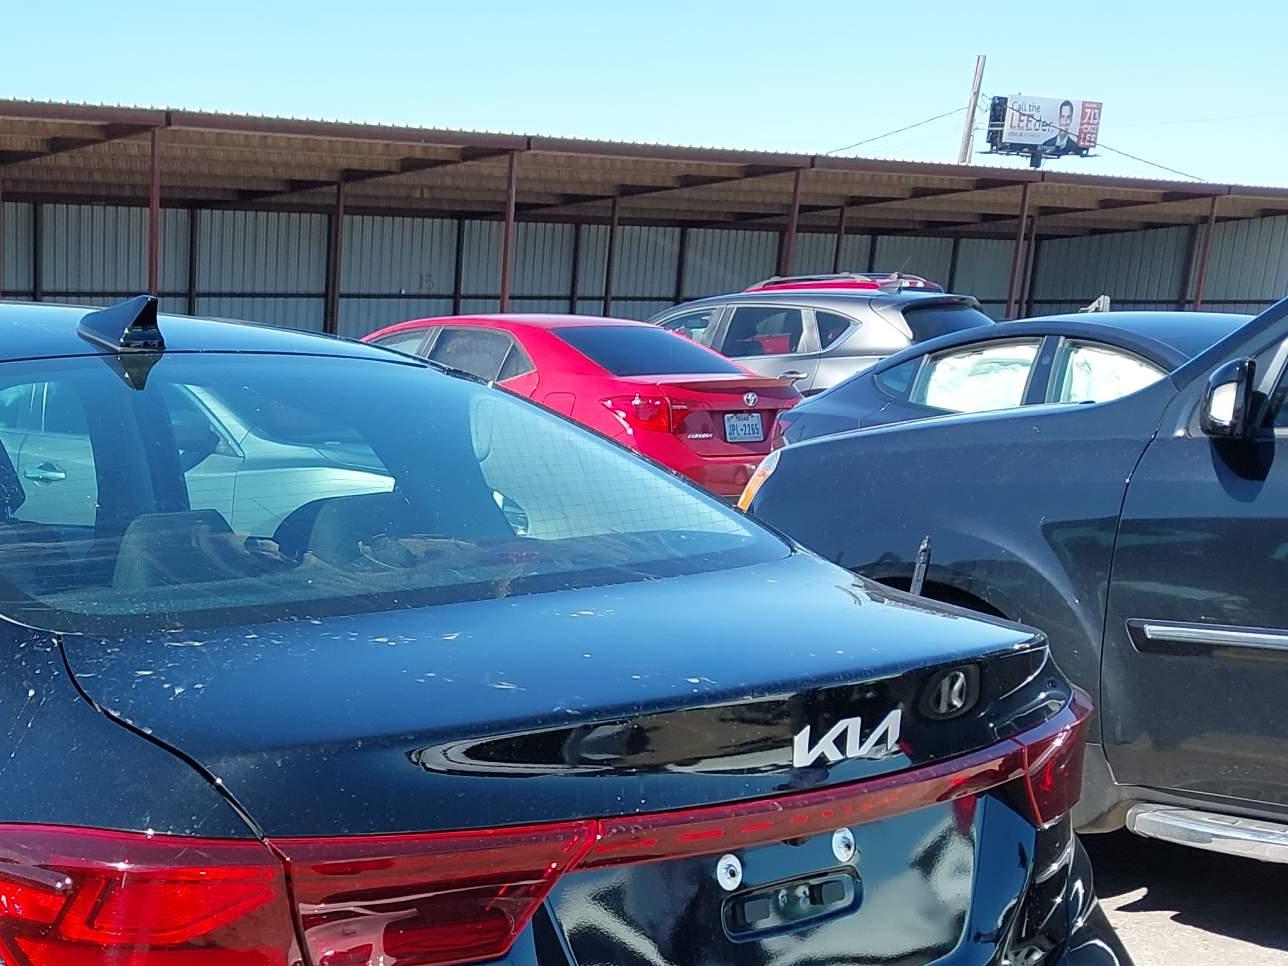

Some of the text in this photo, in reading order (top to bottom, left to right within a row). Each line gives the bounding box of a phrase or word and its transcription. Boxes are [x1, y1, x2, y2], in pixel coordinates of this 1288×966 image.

[1012, 100, 1040, 112] Call the
[1085, 108, 1100, 124] 713
[1080, 132, 1097, 146] LEE
[793, 709, 902, 768] KIA
